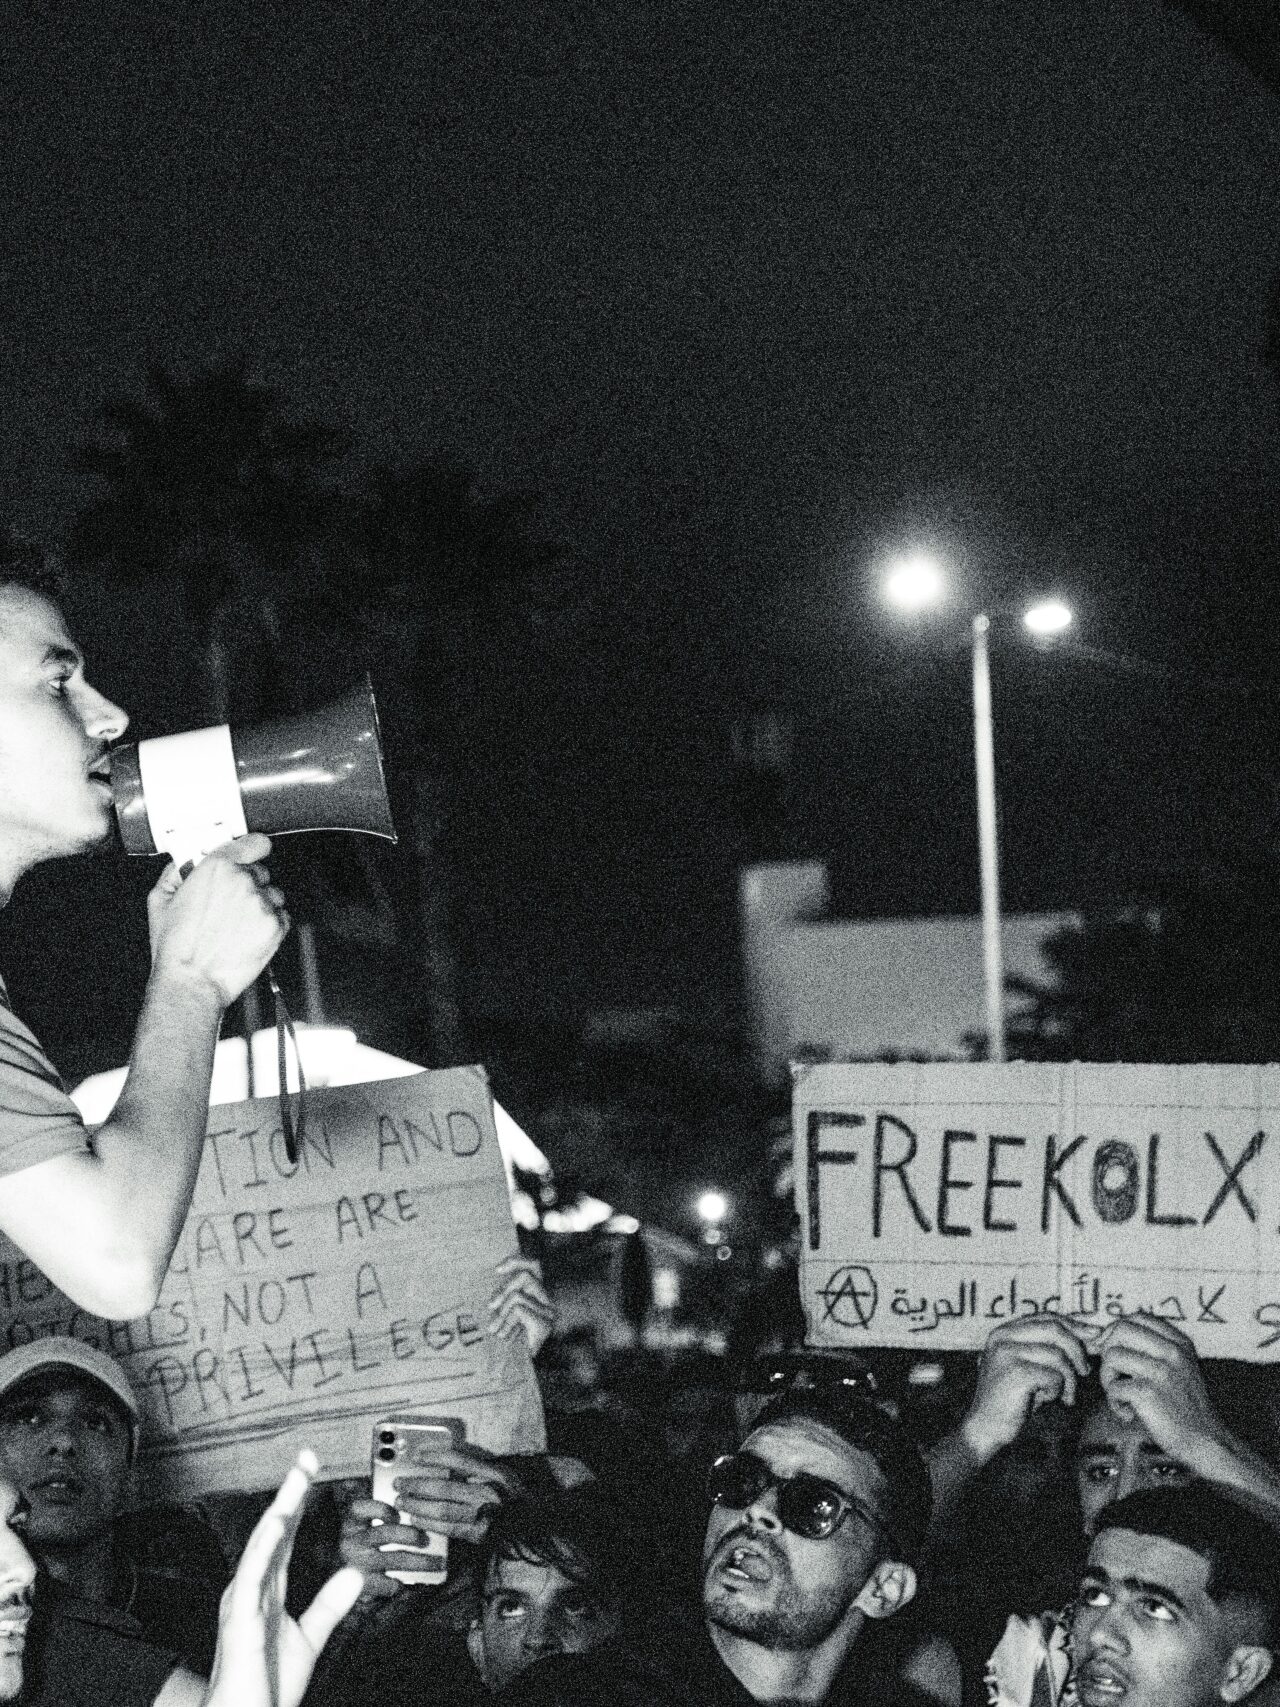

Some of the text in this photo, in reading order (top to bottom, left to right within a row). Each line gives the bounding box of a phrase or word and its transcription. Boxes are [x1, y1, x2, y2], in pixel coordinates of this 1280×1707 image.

[206, 1110, 484, 1197] TION AND
[336, 1187, 418, 1242] ARE
[224, 1271, 318, 1328] NOT
[356, 1262, 388, 1316] A
[890, 1278, 978, 1333] الحرية
[148, 1313, 484, 1425] PRIVILEGE
